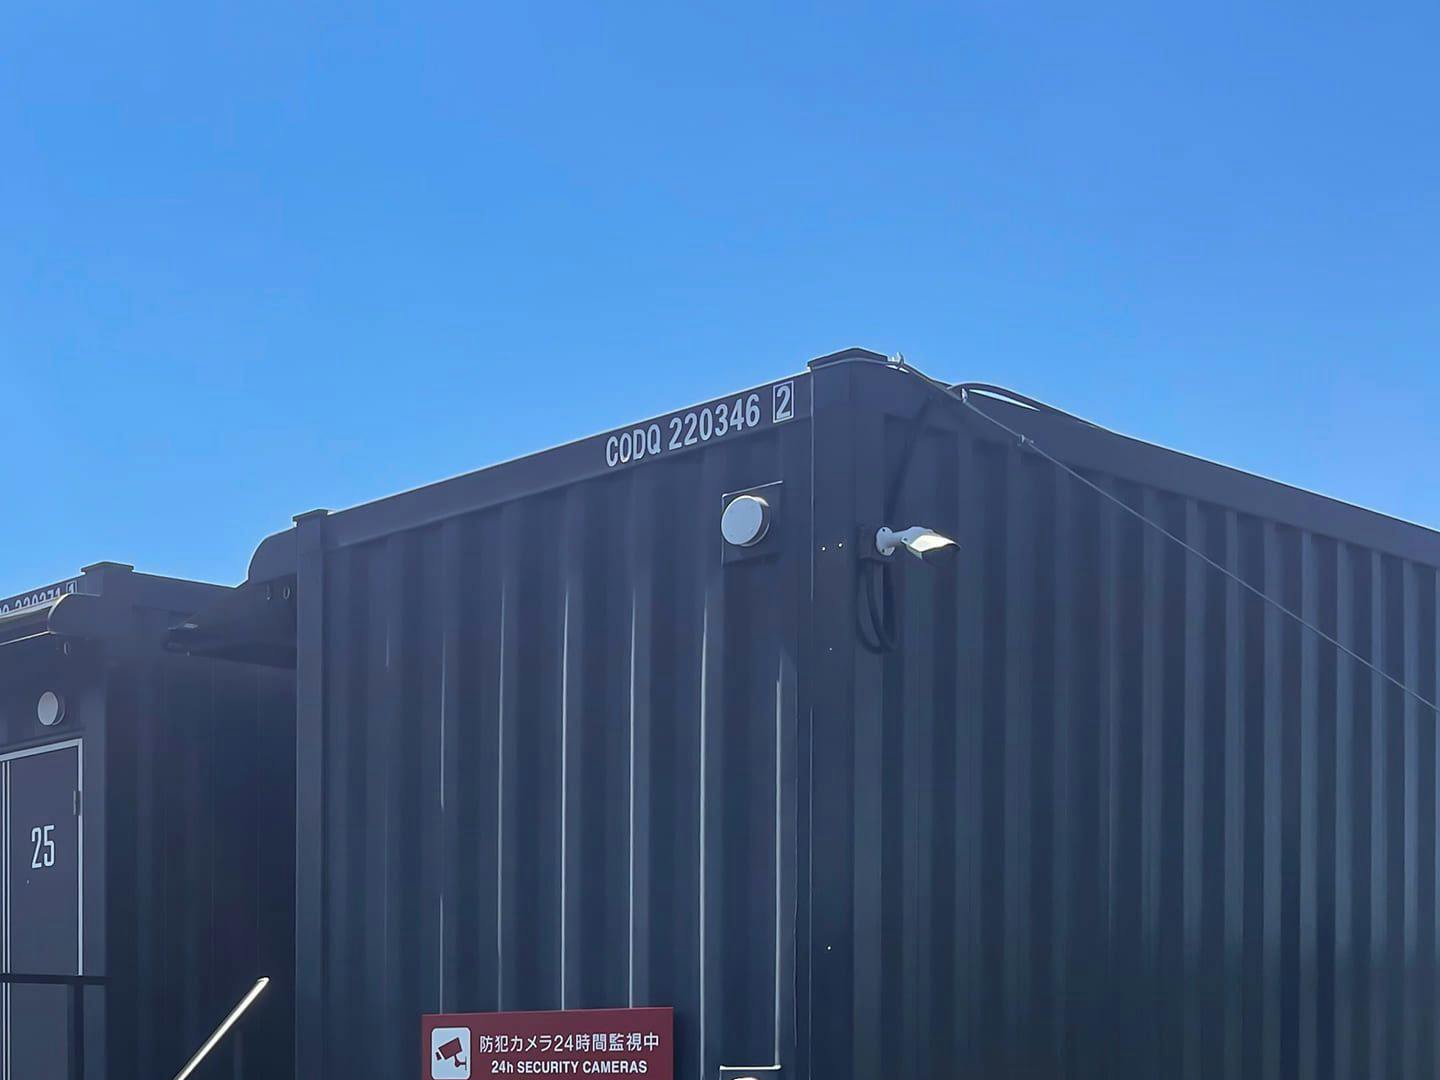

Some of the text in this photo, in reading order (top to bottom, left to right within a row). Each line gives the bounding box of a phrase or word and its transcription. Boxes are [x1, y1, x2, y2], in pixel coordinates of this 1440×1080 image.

[606, 384, 792, 467] CODQ 220346 2
[31, 824, 55, 869] 25
[479, 1032, 660, 1053] 防犯カメラ24時間監視中
[491, 1060, 648, 1074] 24h SECURITY CAMERAS
